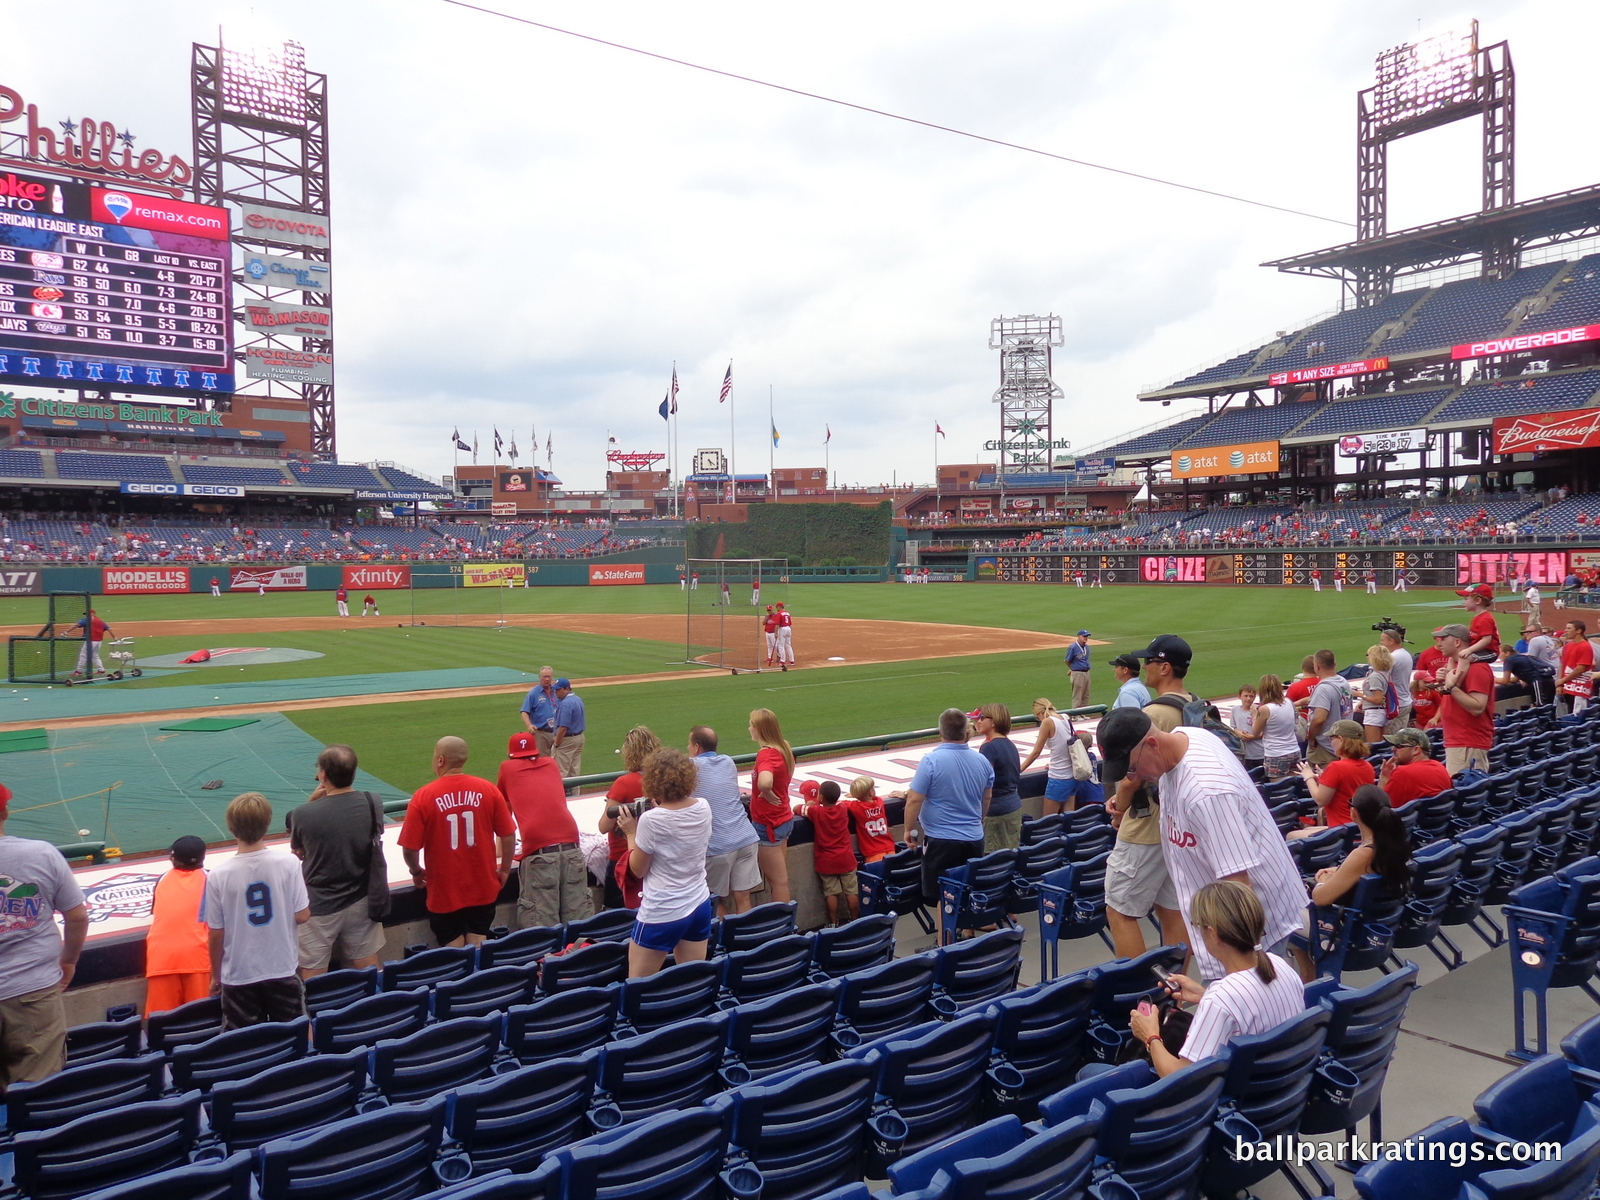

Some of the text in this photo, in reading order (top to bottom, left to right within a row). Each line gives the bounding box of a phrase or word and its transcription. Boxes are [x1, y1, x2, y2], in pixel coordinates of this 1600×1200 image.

[135, 206, 221, 229] remax.com
[38, 218, 77, 235] LEAGUE
[79, 225, 104, 239] EAST
[265, 218, 327, 238] TOYOTA
[76, 243, 87, 255] W
[99, 246, 106, 257] L
[125, 250, 140, 262] GB
[154, 255, 171, 265] LAST
[201, 262, 218, 271] EAST
[73, 259, 88, 272] 62
[95, 262, 110, 274] 44
[157, 271, 175, 283] 4-6
[189, 275, 216, 288] 20-17
[270, 262, 310, 278] Choose
[73, 275, 89, 288] 56
[95, 279, 110, 291] 50
[124, 282, 142, 295] 6.0
[157, 286, 175, 299] 7-3
[190, 290, 217, 304] 24-18
[74, 293, 89, 305] 55
[97, 295, 110, 307] 51
[125, 298, 142, 311] 7.0
[158, 302, 176, 315] 4-6
[190, 305, 218, 319] 20-19
[74, 309, 90, 322] 53
[96, 312, 112, 324] 54
[125, 315, 143, 327] 9.5
[158, 318, 177, 331] 5-5
[190, 321, 218, 335] 18-24
[1, 319, 217, 350] JAYS 51 55 11.0 3-7 15-19
[1471, 328, 1587, 356] POWERADE
[247, 348, 332, 365] HORIZON
[252, 372, 328, 384] HEATING COOLING
[271, 367, 309, 376] PLUMBING
[1293, 367, 1336, 381] $1 ANY SIZE
[21, 396, 224, 427] Citizens Bank Park
[127, 423, 163, 431] HARRY
[1497, 423, 1600, 444] Budweiser
[985, 437, 1069, 451] Citizens Bank
[1013, 452, 1040, 464] Park
[1194, 455, 1219, 469] at&t
[1247, 450, 1273, 464] at&t
[127, 483, 178, 494] GEICO
[191, 486, 239, 495] GEICO
[356, 490, 453, 501] Jefferson University Hospitals
[107, 571, 187, 584] MODELL'S
[351, 569, 403, 586] xfinity
[1458, 553, 1566, 584] CITIZEN
[435, 791, 483, 813] ROLLINS
[446, 811, 475, 850] 11
[94, 886, 155, 903] NATION
[246, 881, 274, 928] 9
